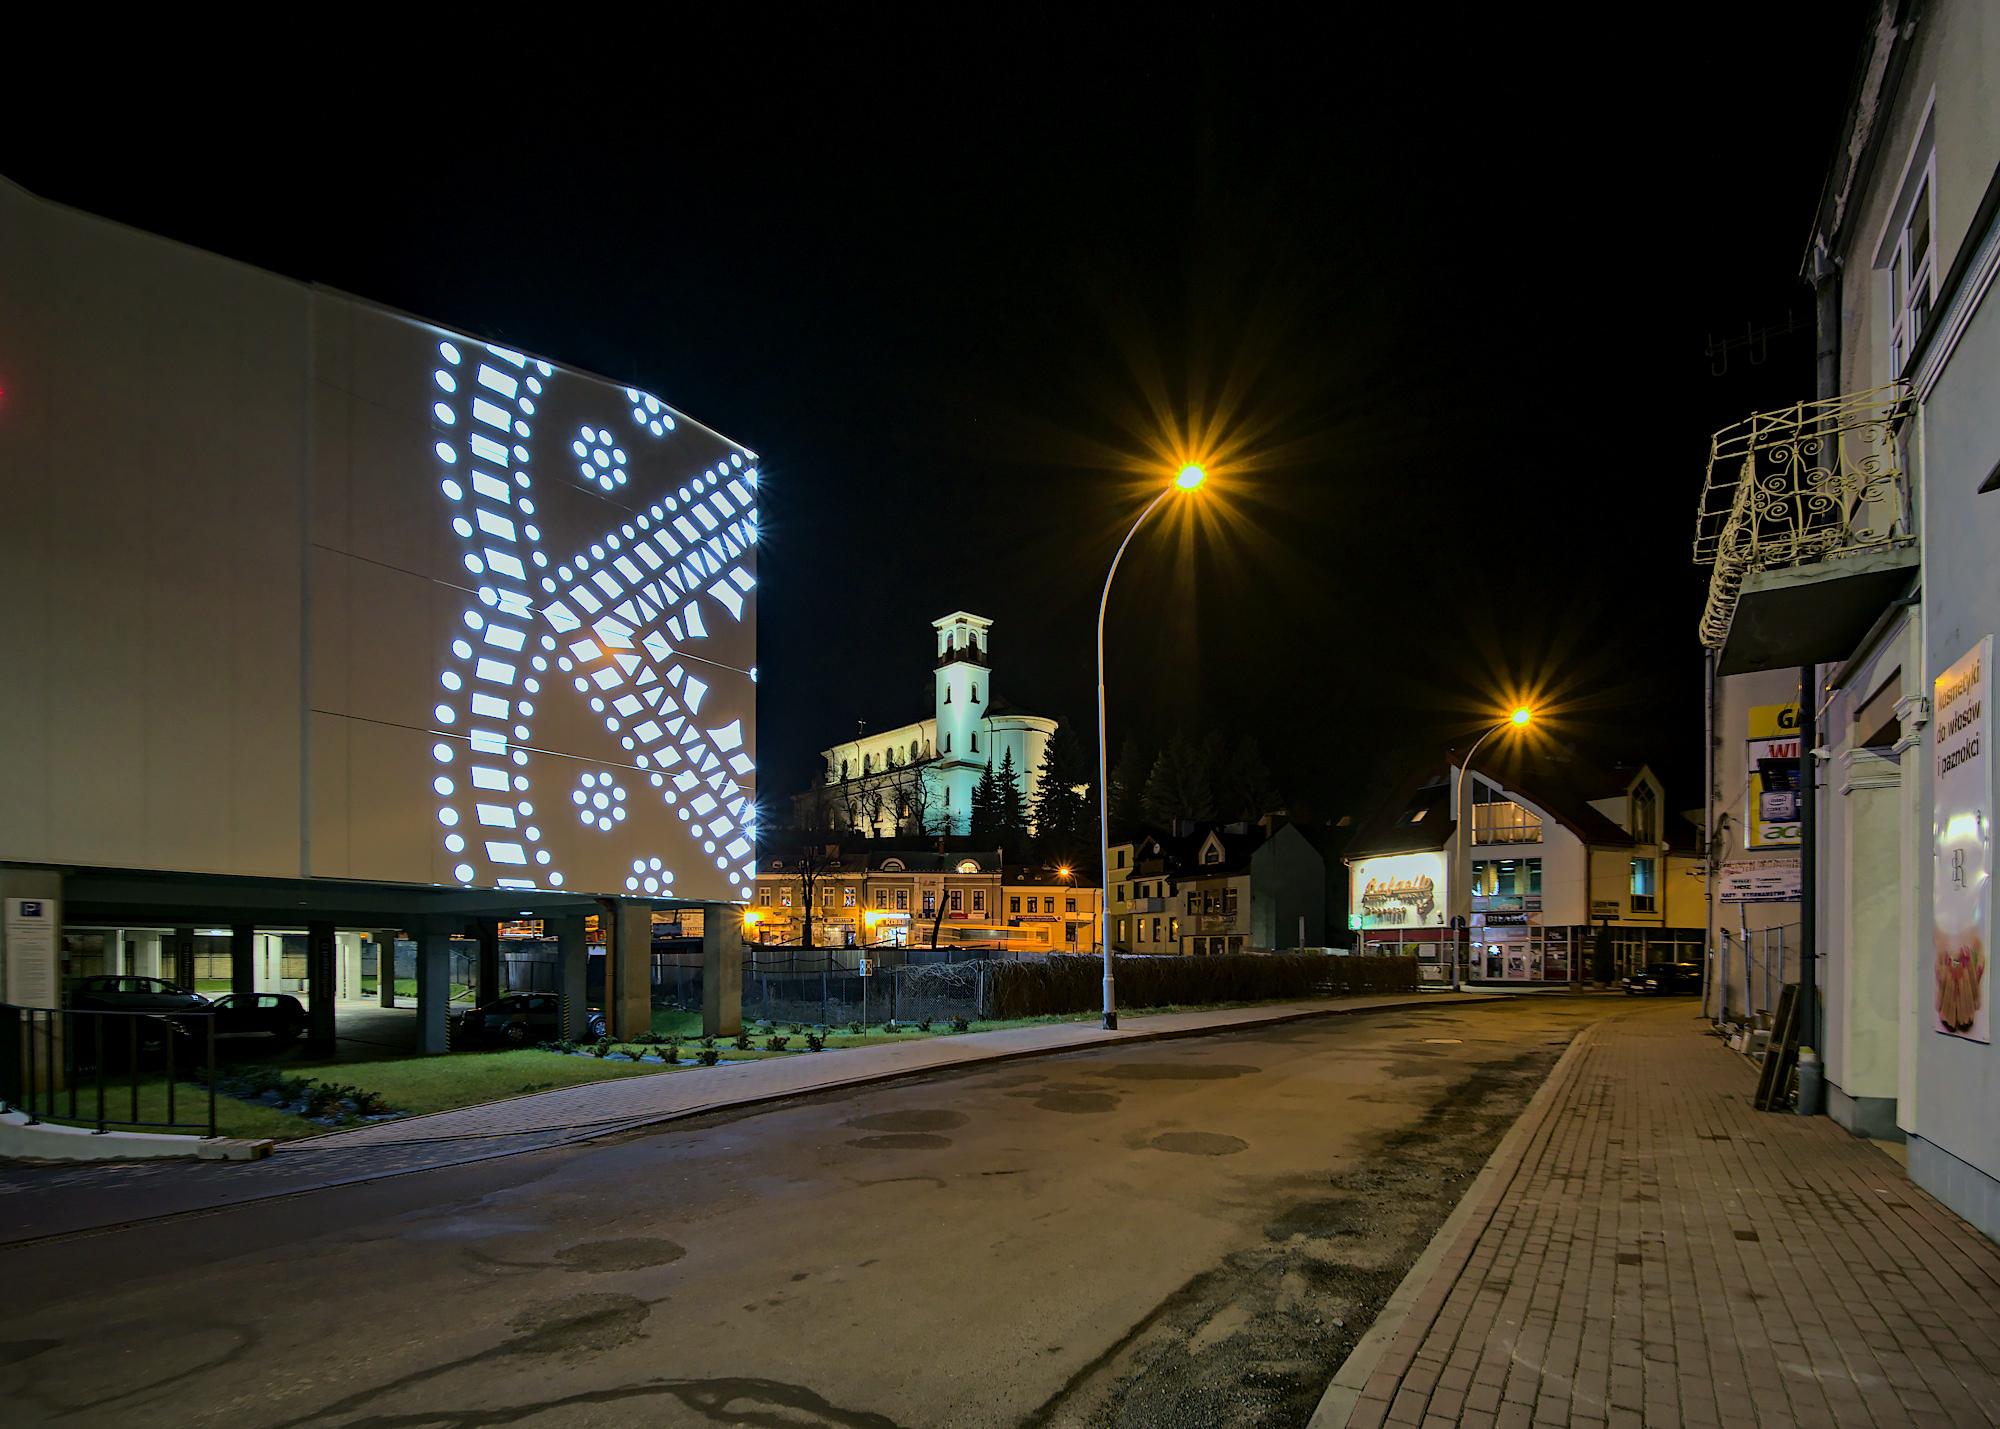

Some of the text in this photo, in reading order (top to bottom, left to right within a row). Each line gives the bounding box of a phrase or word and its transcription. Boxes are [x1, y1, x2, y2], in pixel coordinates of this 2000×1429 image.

[1938, 658, 1981, 712] kosmetyki
[1937, 699, 1981, 745] do włosów
[1941, 731, 1979, 779] paznokci
